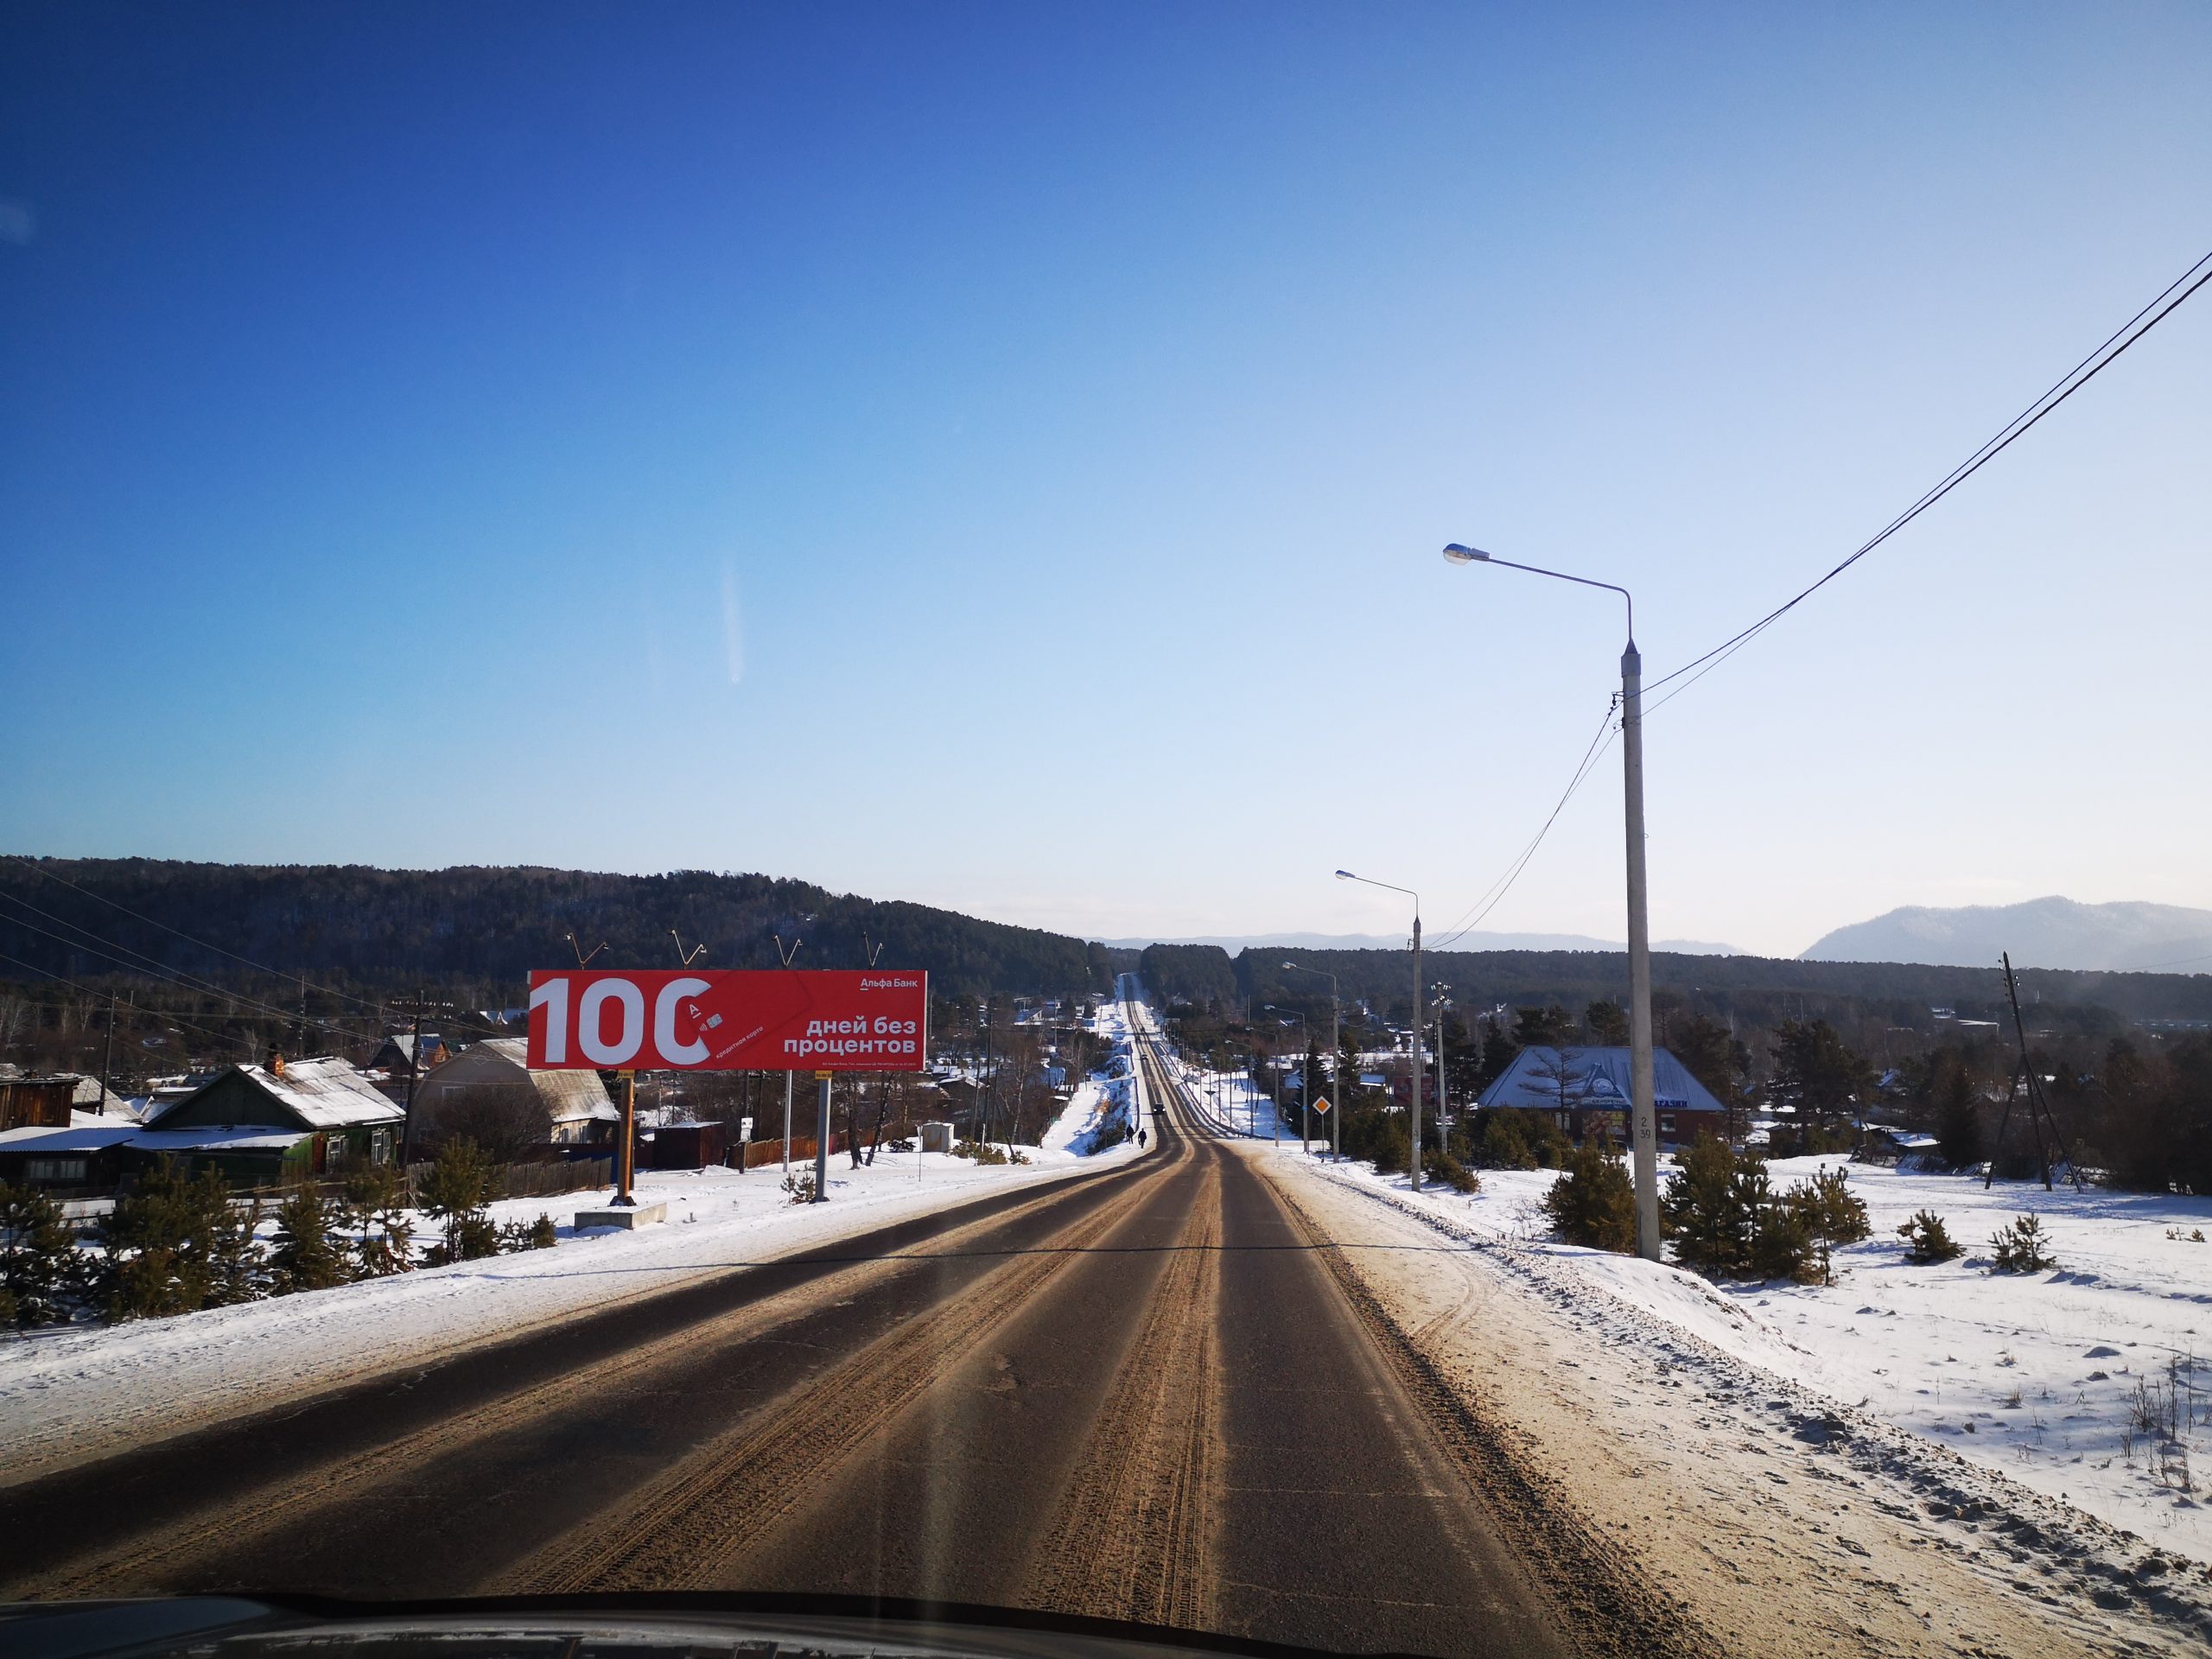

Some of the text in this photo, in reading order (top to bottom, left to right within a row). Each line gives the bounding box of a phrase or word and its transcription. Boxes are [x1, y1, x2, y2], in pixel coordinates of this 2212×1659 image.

[860, 978, 918, 990] Альфа Банк
[806, 1015, 916, 1037] дней без
[715, 1037, 746, 1059] кредитная
[784, 1039, 916, 1057] процентов
[1641, 1117, 1648, 1127] 2
[1640, 1129, 1651, 1139] 39
